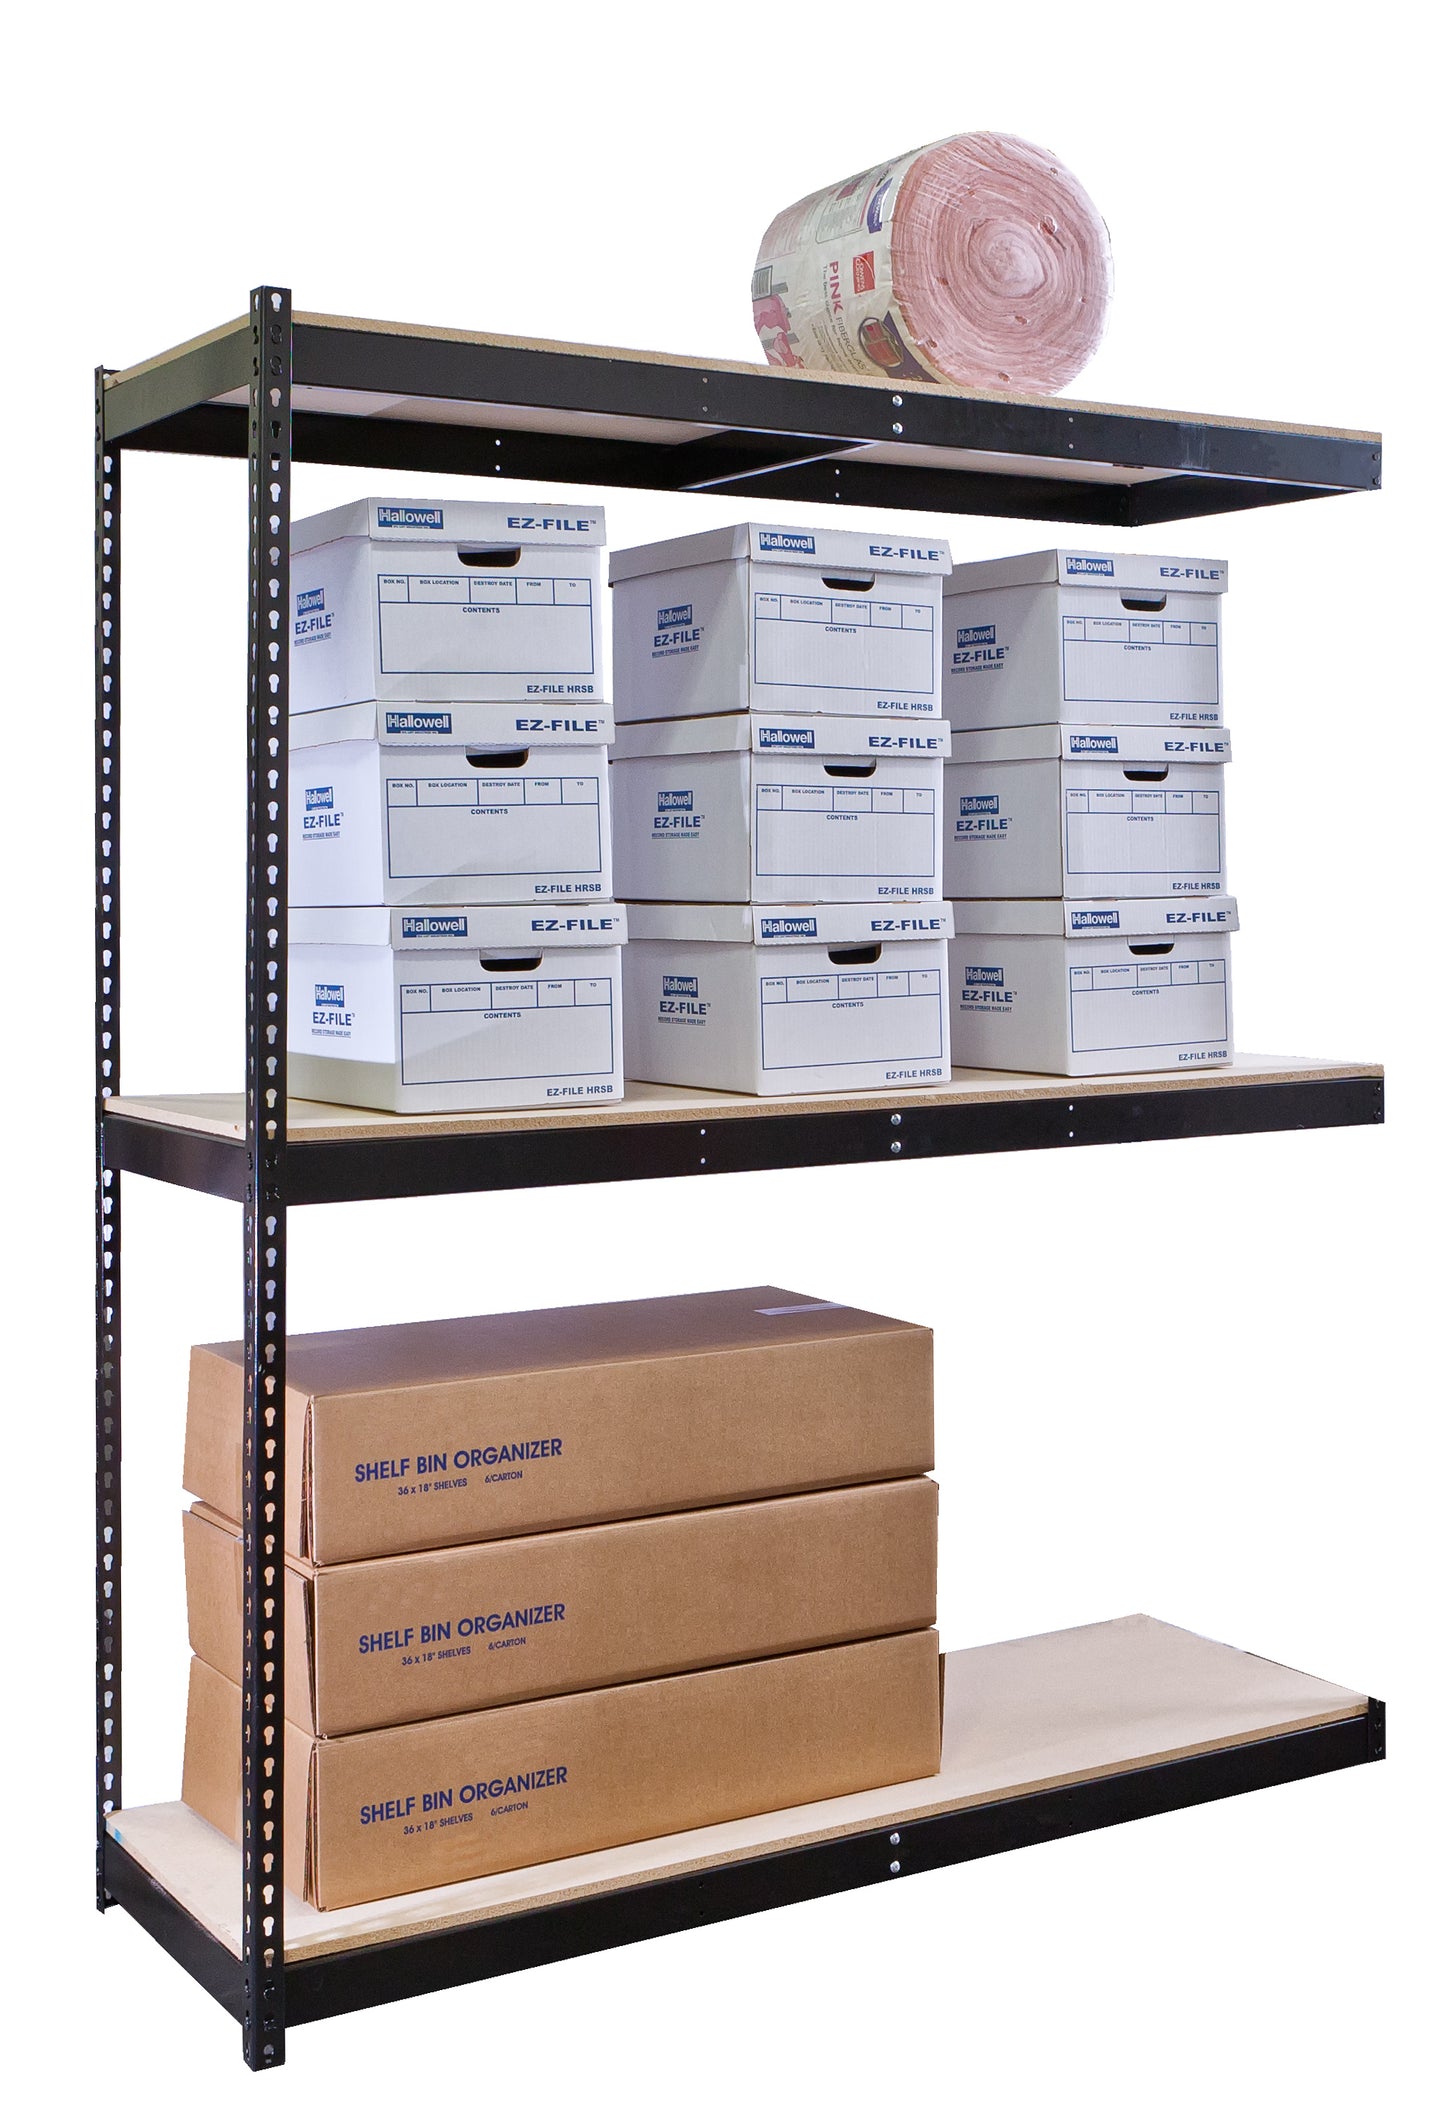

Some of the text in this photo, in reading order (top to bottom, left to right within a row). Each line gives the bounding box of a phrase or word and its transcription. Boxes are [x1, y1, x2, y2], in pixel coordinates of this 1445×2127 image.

[829, 261, 844, 315] PINK
[378, 510, 441, 524] Hallowell
[760, 534, 813, 549] Hallowell
[1067, 559, 1112, 573] Hallowell
[297, 592, 324, 609] Hallowell
[658, 608, 691, 624] Hallowell
[958, 628, 994, 643] Hallowell
[527, 685, 594, 693] EZ-FILE HRSB
[877, 701, 933, 711] EZ-FILE HRSB
[387, 715, 449, 728] Hallowell
[761, 730, 812, 744] Hallowell
[1071, 738, 1116, 749] Hallowell
[305, 789, 332, 804] Hallowell
[658, 794, 691, 807] Hallowell
[960, 798, 998, 810] Hallowell
[535, 883, 601, 893] EZ-FILE HRSB
[403, 919, 464, 932] Hallowell
[1072, 913, 1118, 924] Hallowell
[763, 920, 815, 932] Hallowell
[966, 969, 1002, 982] Hallowell
[663, 978, 697, 993] Hallowell
[315, 986, 343, 1002] Hallowell
[1178, 1052, 1227, 1061] EZ-FILE HRSB
[886, 1069, 942, 1080] EZ-FILE HRSB
[547, 1085, 613, 1096] EZ-FILE HRSB
[355, 1438, 562, 1483] SHELF BIN ORGANIZER
[398, 1486, 409, 1495] 36
[418, 1483, 432, 1493] 18"
[434, 1478, 467, 1491] SHELVES
[484, 1470, 523, 1484] 6/CARTON
[359, 1604, 565, 1654] SHELF BIN ORGANIZER
[402, 1656, 412, 1665] 36
[423, 1652, 436, 1662] 18"
[438, 1646, 471, 1660] SHELVES
[488, 1636, 526, 1650] 6/CARTON
[360, 1766, 568, 1825] SHELF BIN ORGANIZER
[403, 1825, 414, 1835] 36
[424, 1820, 438, 1831] 18"
[439, 1812, 473, 1828] SHELVES
[490, 1801, 528, 1816] 6/CARTON
